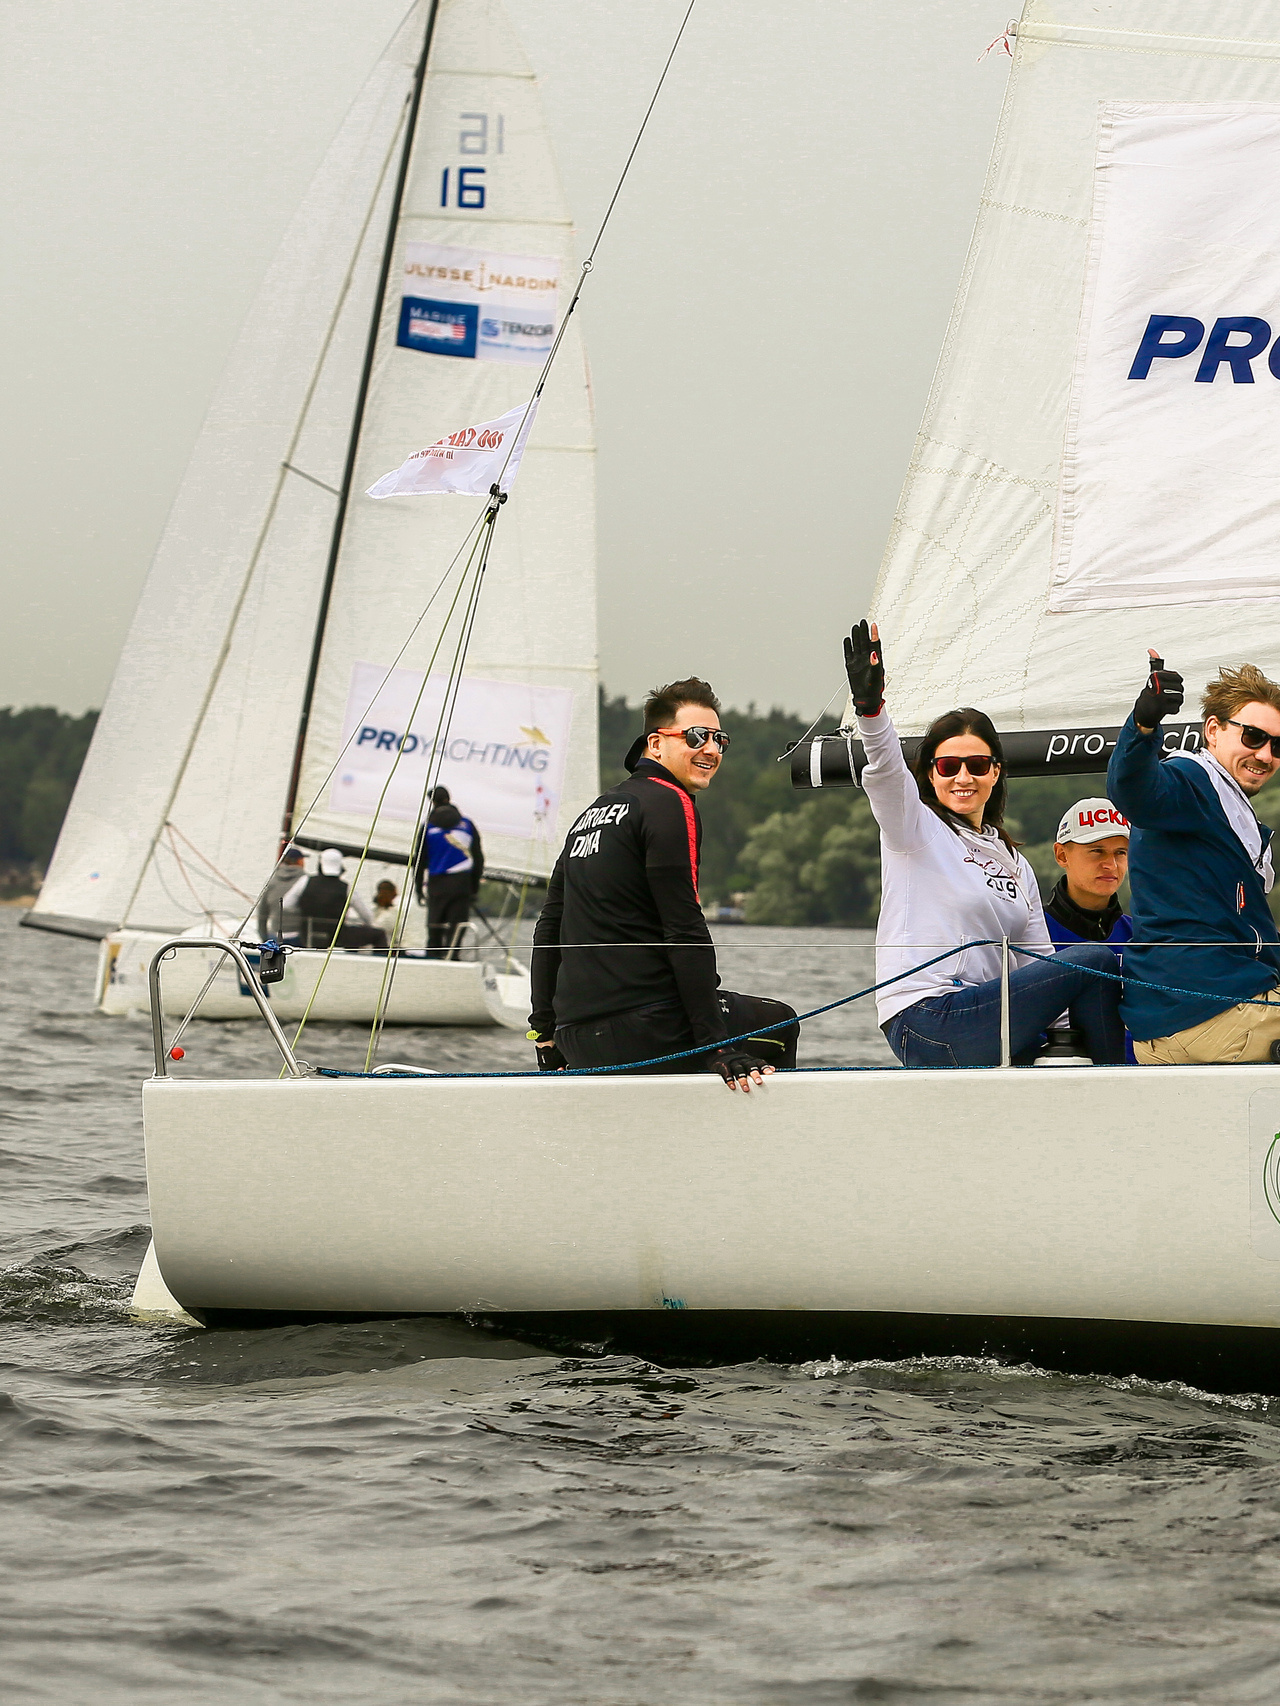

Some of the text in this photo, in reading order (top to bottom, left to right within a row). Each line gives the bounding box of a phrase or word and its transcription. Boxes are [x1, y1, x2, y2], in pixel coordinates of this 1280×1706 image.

[440, 167, 486, 209] 16
[489, 273, 557, 289] NARDIN
[502, 320, 554, 336] TENZOR
[357, 726, 550, 772] PROYACHTING
